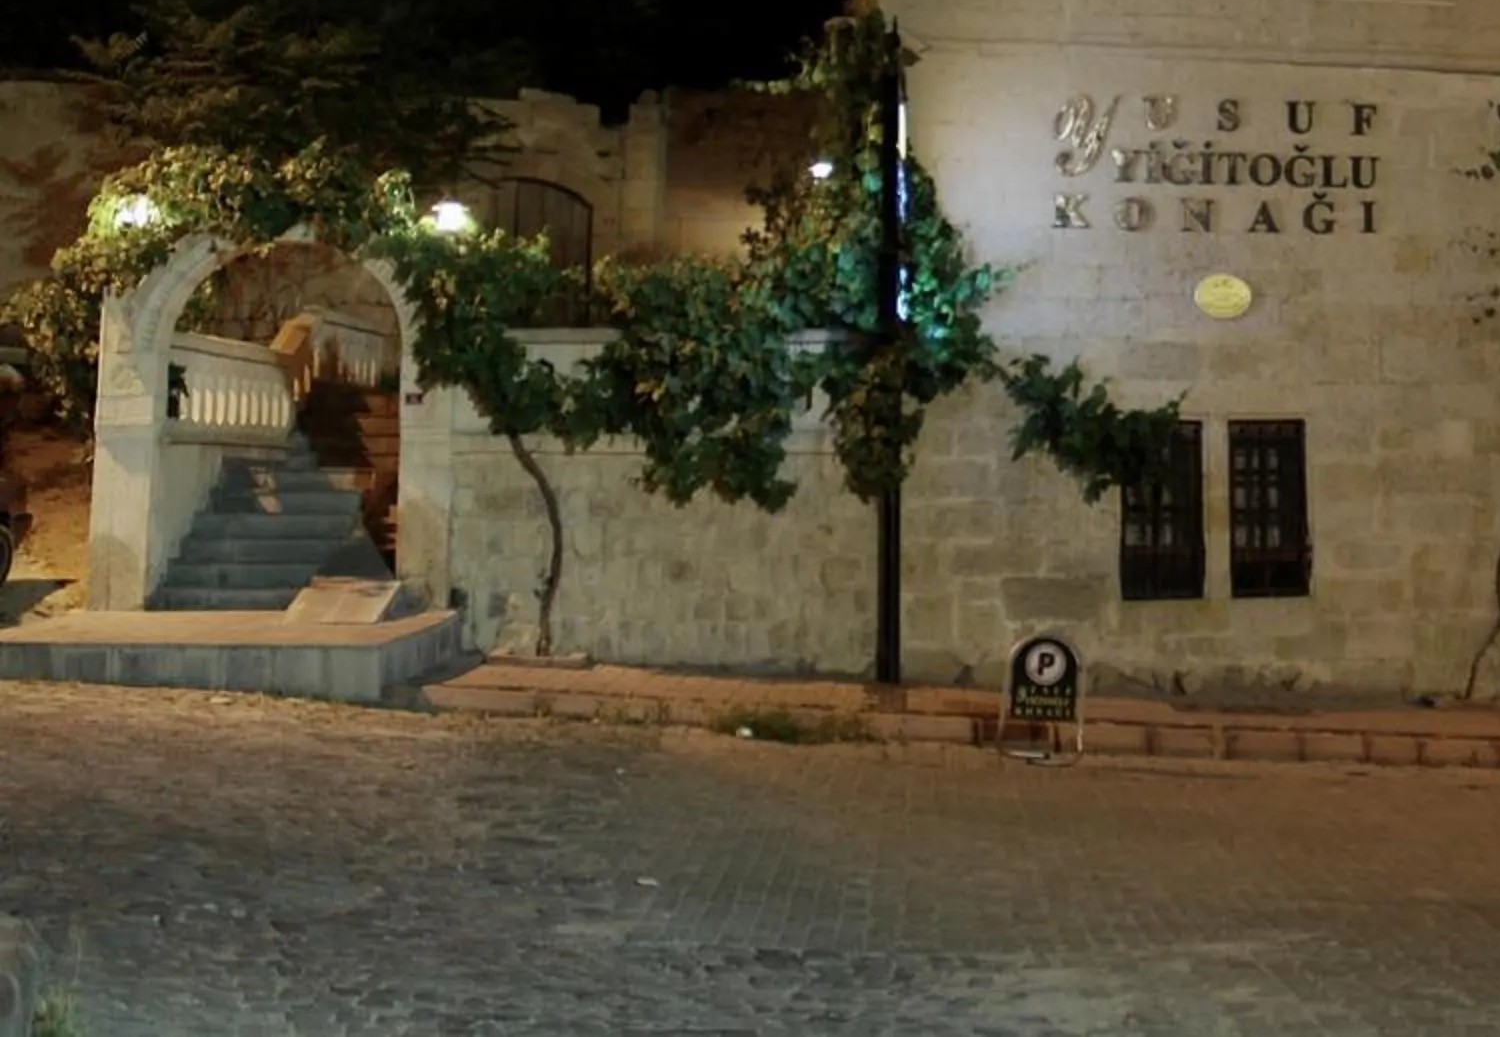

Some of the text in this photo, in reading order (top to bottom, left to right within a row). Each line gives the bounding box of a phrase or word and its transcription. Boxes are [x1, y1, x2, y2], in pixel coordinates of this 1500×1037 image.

[1052, 92, 1378, 177] YUSUF
[1111, 139, 1382, 189] YİĞİTOĞLU
[1051, 191, 1377, 234] KONAĞI
[1037, 652, 1055, 676] P
